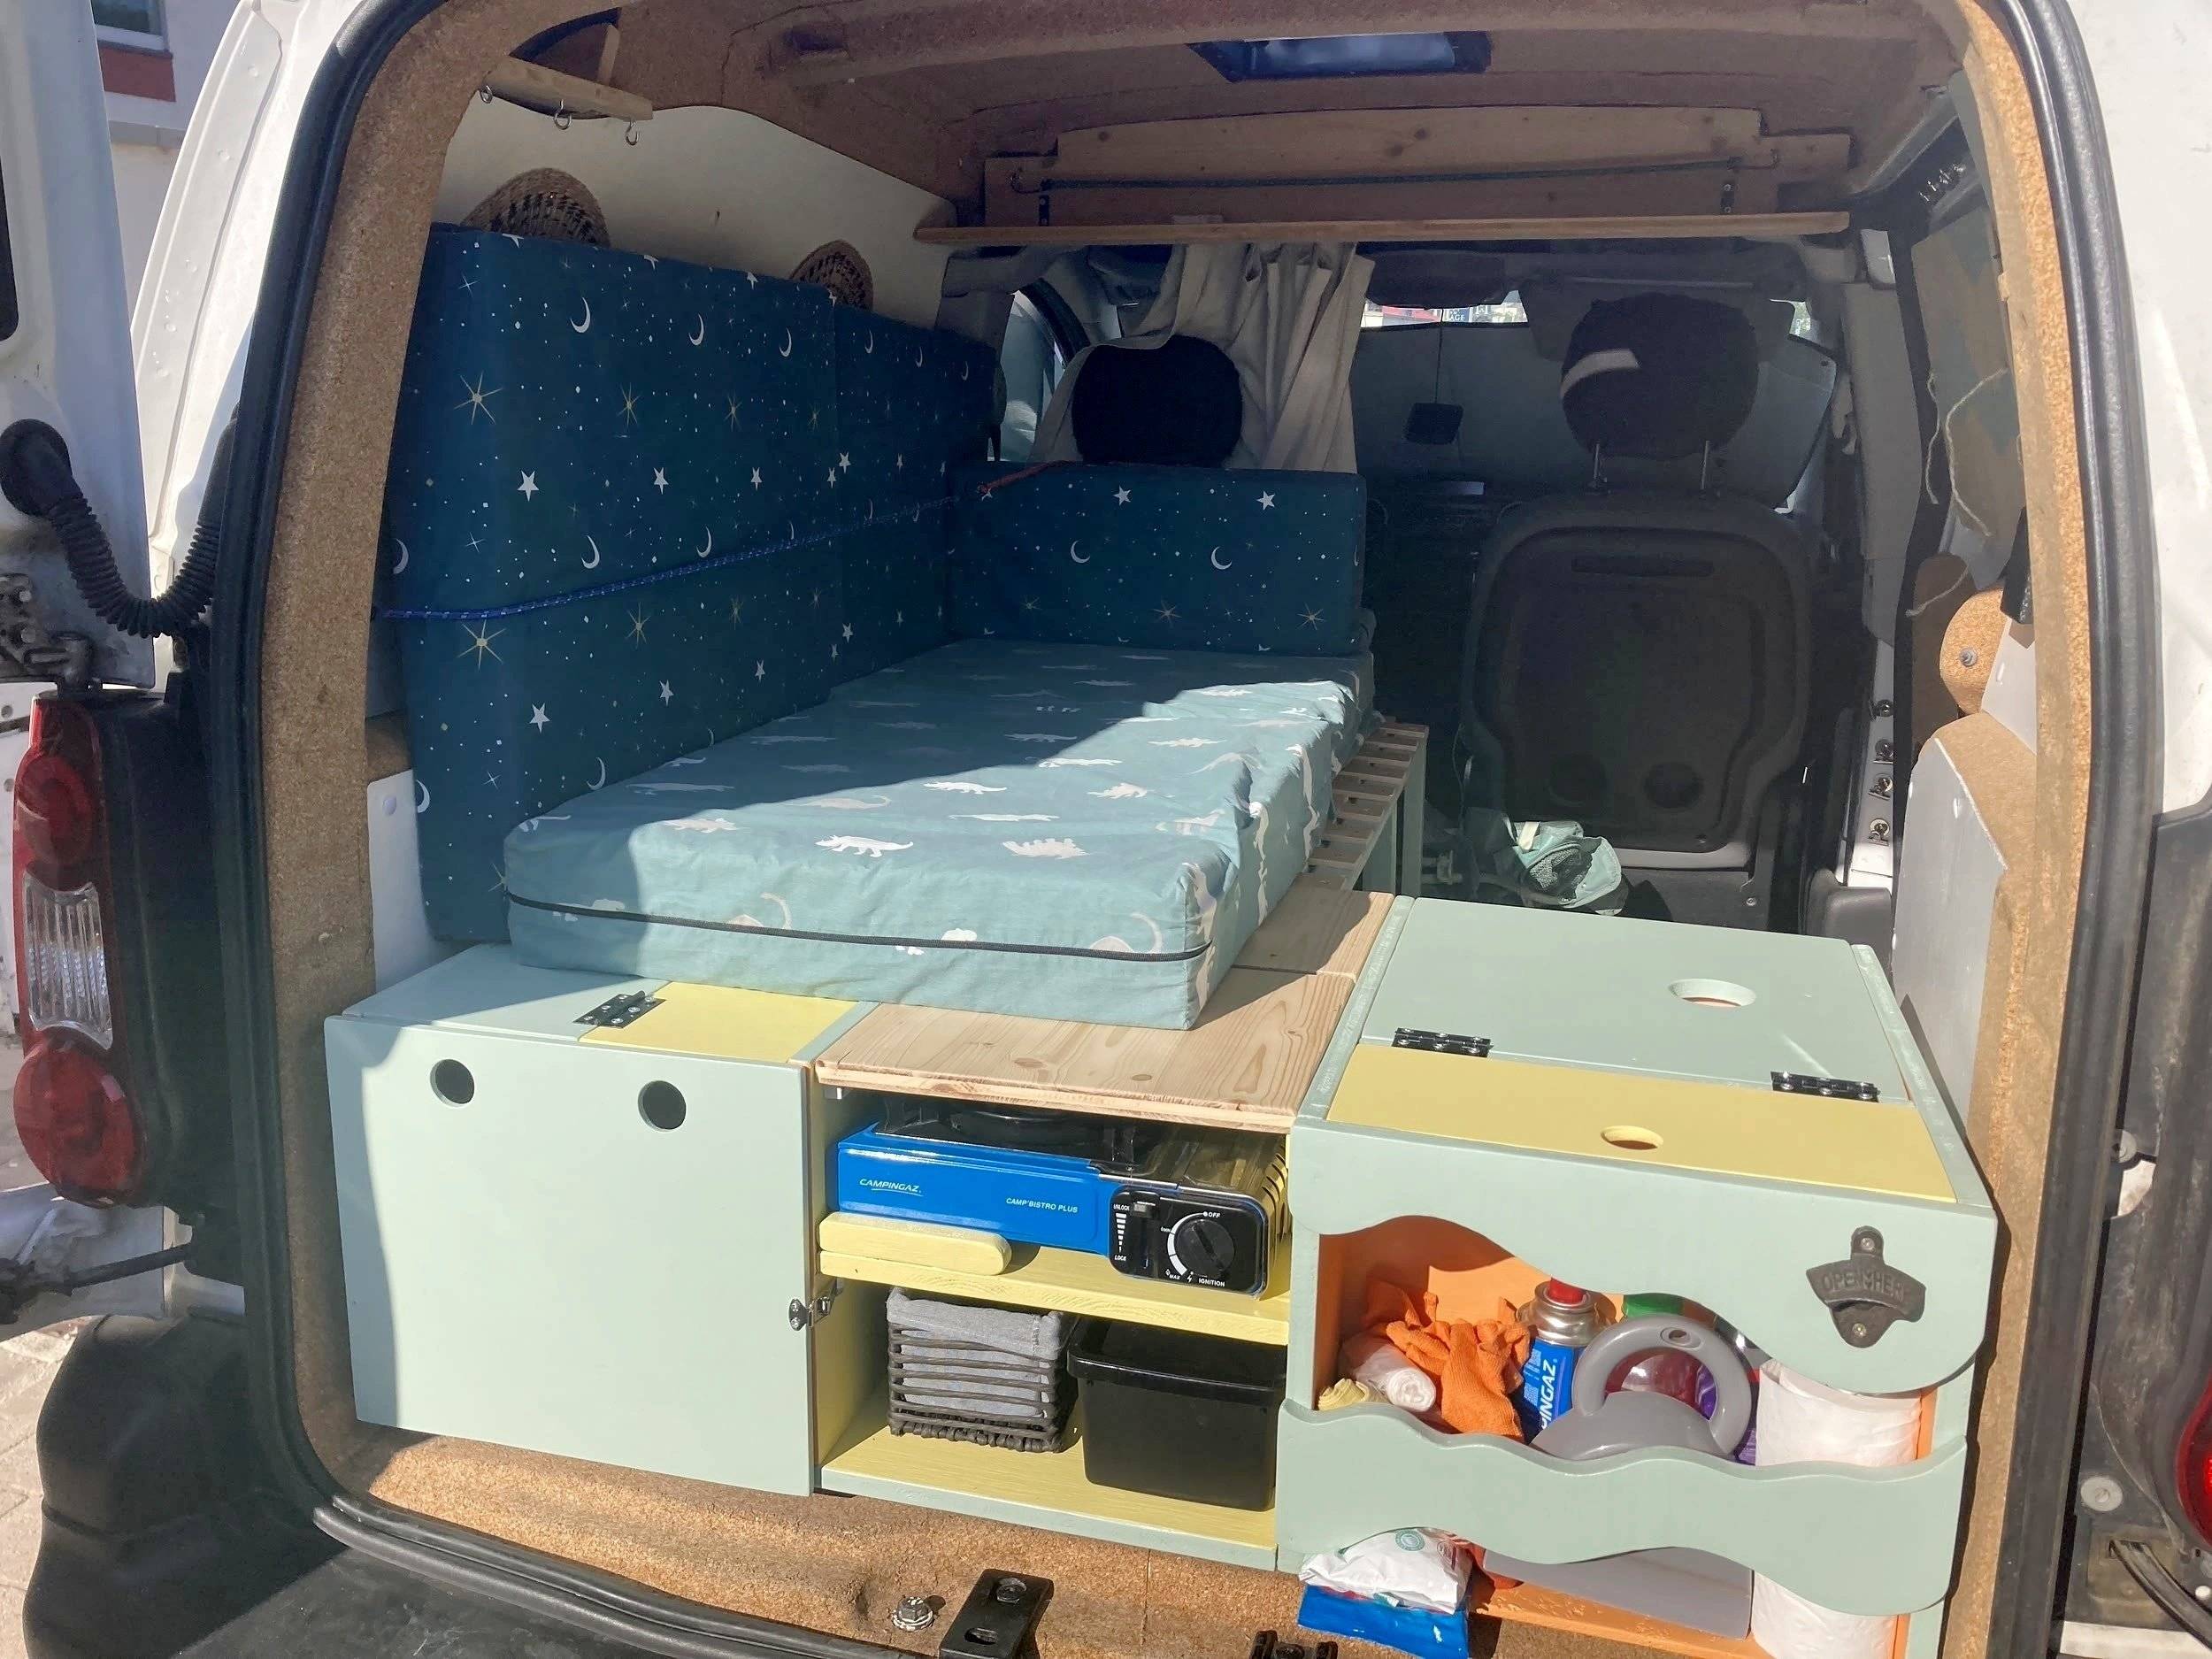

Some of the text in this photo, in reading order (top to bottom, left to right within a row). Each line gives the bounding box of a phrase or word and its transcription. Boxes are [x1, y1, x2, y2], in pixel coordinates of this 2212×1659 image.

[859, 1178, 920, 1193] CAMPINGAZ
[1057, 1204, 1079, 1213] PLUS
[1198, 1278, 1225, 1287] IGNITION
